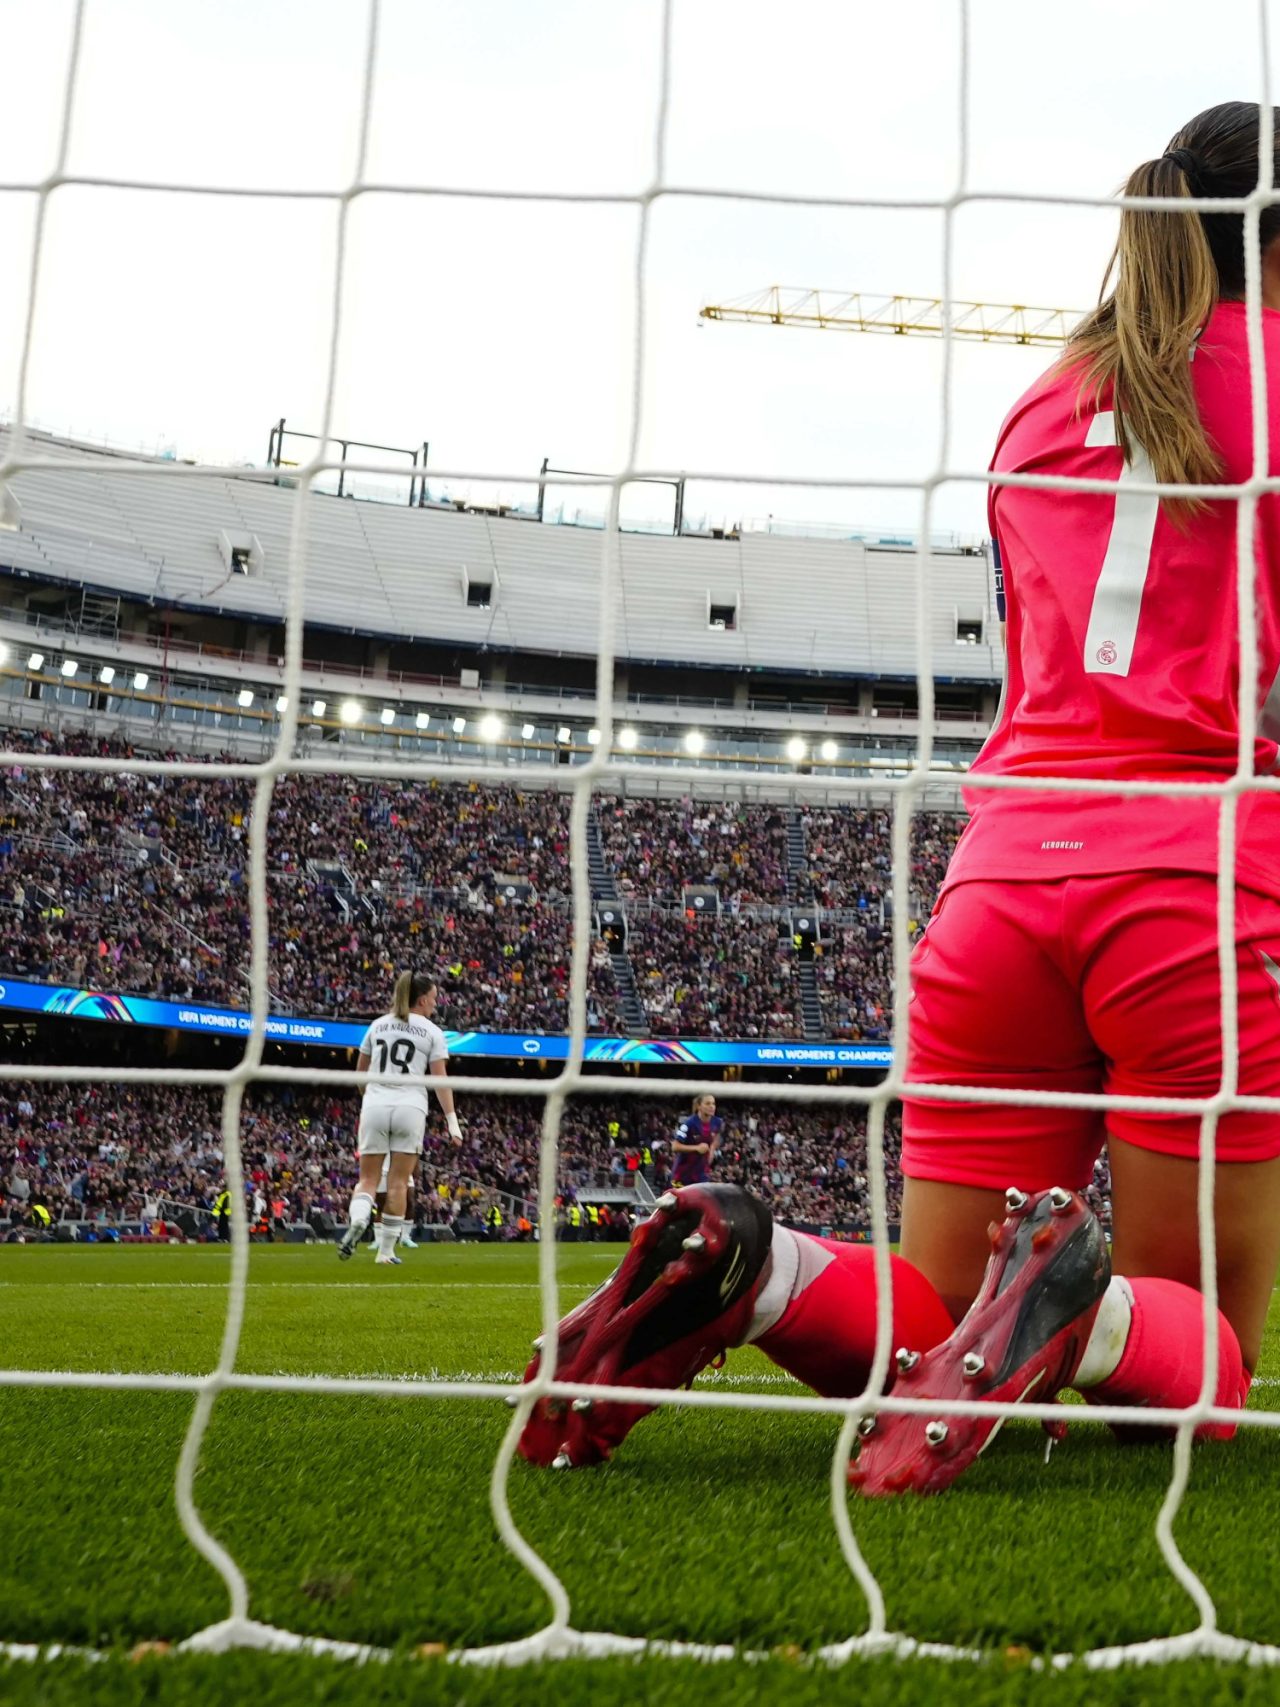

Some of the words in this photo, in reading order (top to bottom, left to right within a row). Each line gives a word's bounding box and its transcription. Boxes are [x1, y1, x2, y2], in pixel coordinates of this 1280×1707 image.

[1041, 841, 1084, 849] AEROREADY
[178, 1010, 199, 1024] UEFA
[376, 1038, 416, 1074] 19
[757, 1049, 783, 1059] UEFA
